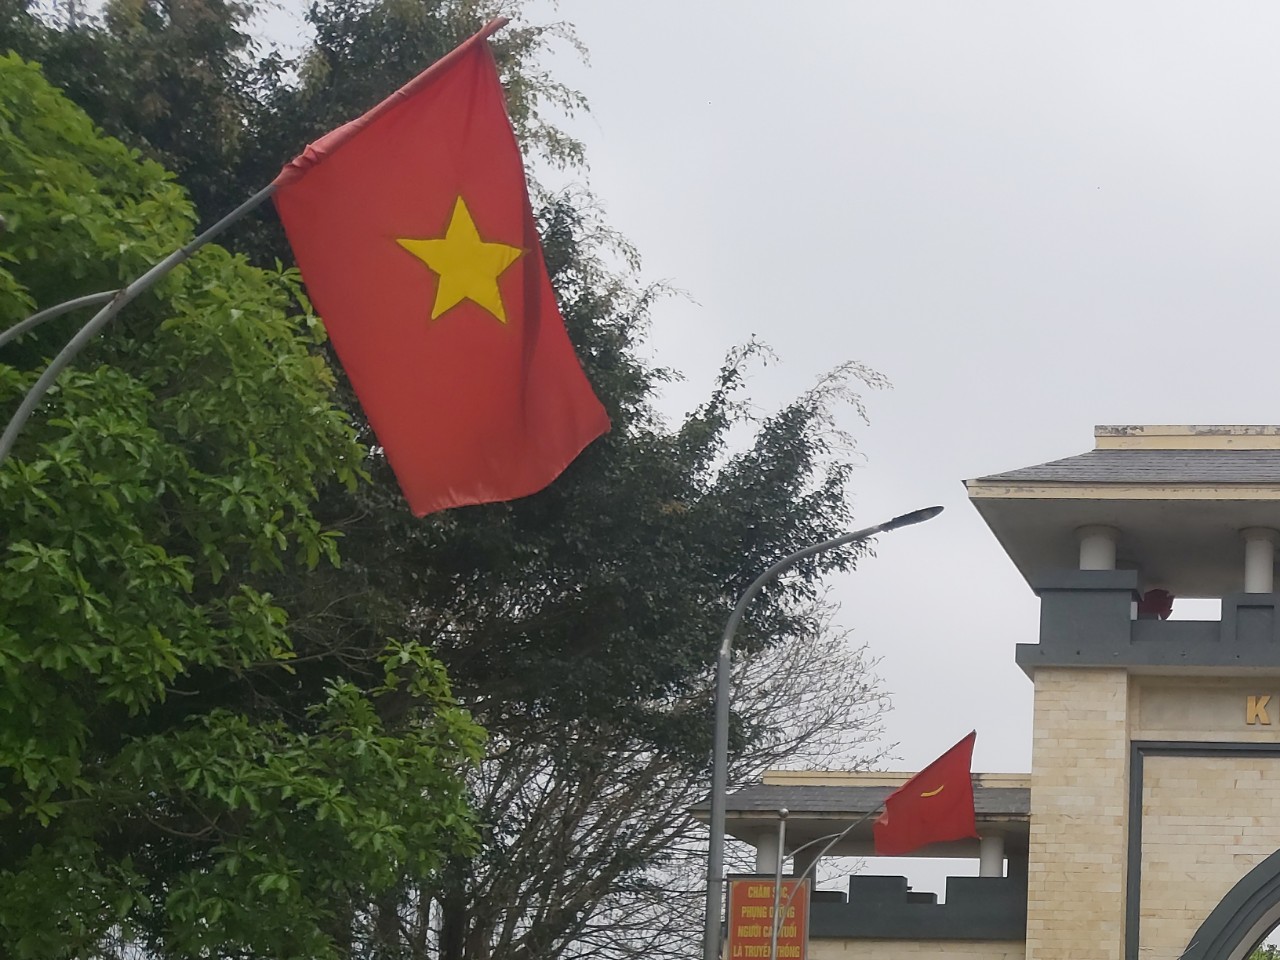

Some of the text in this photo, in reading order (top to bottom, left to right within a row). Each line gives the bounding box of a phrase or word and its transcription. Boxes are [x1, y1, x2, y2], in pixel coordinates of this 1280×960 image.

[772, 885, 790, 899] SC,
[741, 904, 795, 920] PHỤNG DỠNG
[738, 923, 761, 938] NGƯỜI
[763, 925, 777, 938] CA
[733, 943, 742, 957] LÀ
